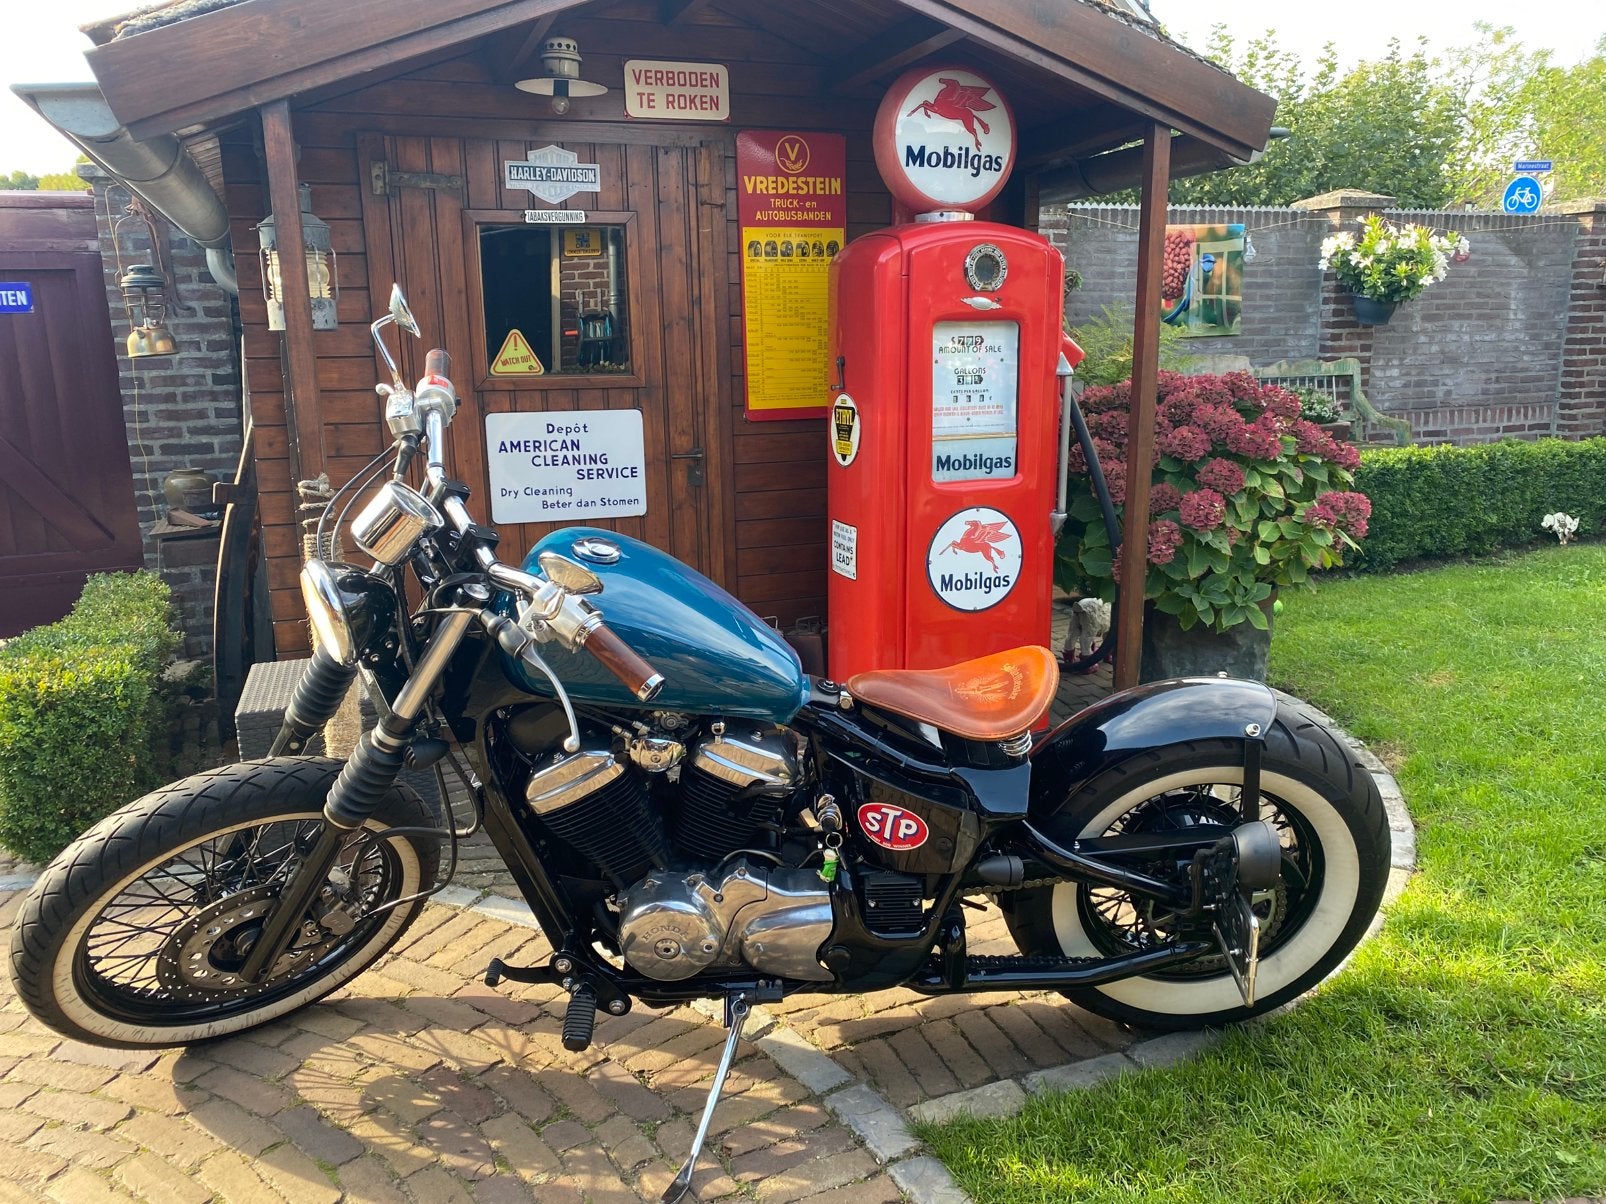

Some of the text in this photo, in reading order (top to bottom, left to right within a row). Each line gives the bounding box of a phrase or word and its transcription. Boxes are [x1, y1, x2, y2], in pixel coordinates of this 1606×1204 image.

[632, 69, 720, 88] VERBODEN
[637, 92, 720, 111] TE ROKEN
[905, 145, 1003, 177] Mobilgas
[510, 166, 596, 183] HARLEY-DAVIDSON
[743, 176, 841, 195] VREDESTEIN
[526, 210, 584, 223] TABAKSVERGUNNING
[755, 211, 832, 221] AUTOBUSBANDEN
[0, 290, 28, 306] TEN
[938, 346, 970, 354] AMOUNT
[985, 345, 1002, 353] SALE
[501, 355, 531, 366] WATCH OUT
[954, 367, 986, 375] GALLONS
[546, 423, 589, 436] Depôt
[499, 439, 580, 453] AMERICAN
[531, 453, 608, 467] CLEANING
[936, 453, 1012, 474] Mobilgas
[576, 467, 638, 480] SERVICE
[501, 485, 573, 499] Dry Cleaning
[542, 497, 639, 509] Beter dan Stomen
[940, 571, 1010, 594] Mobilgas
[865, 807, 919, 840] STP
[641, 925, 689, 942] HONDA
